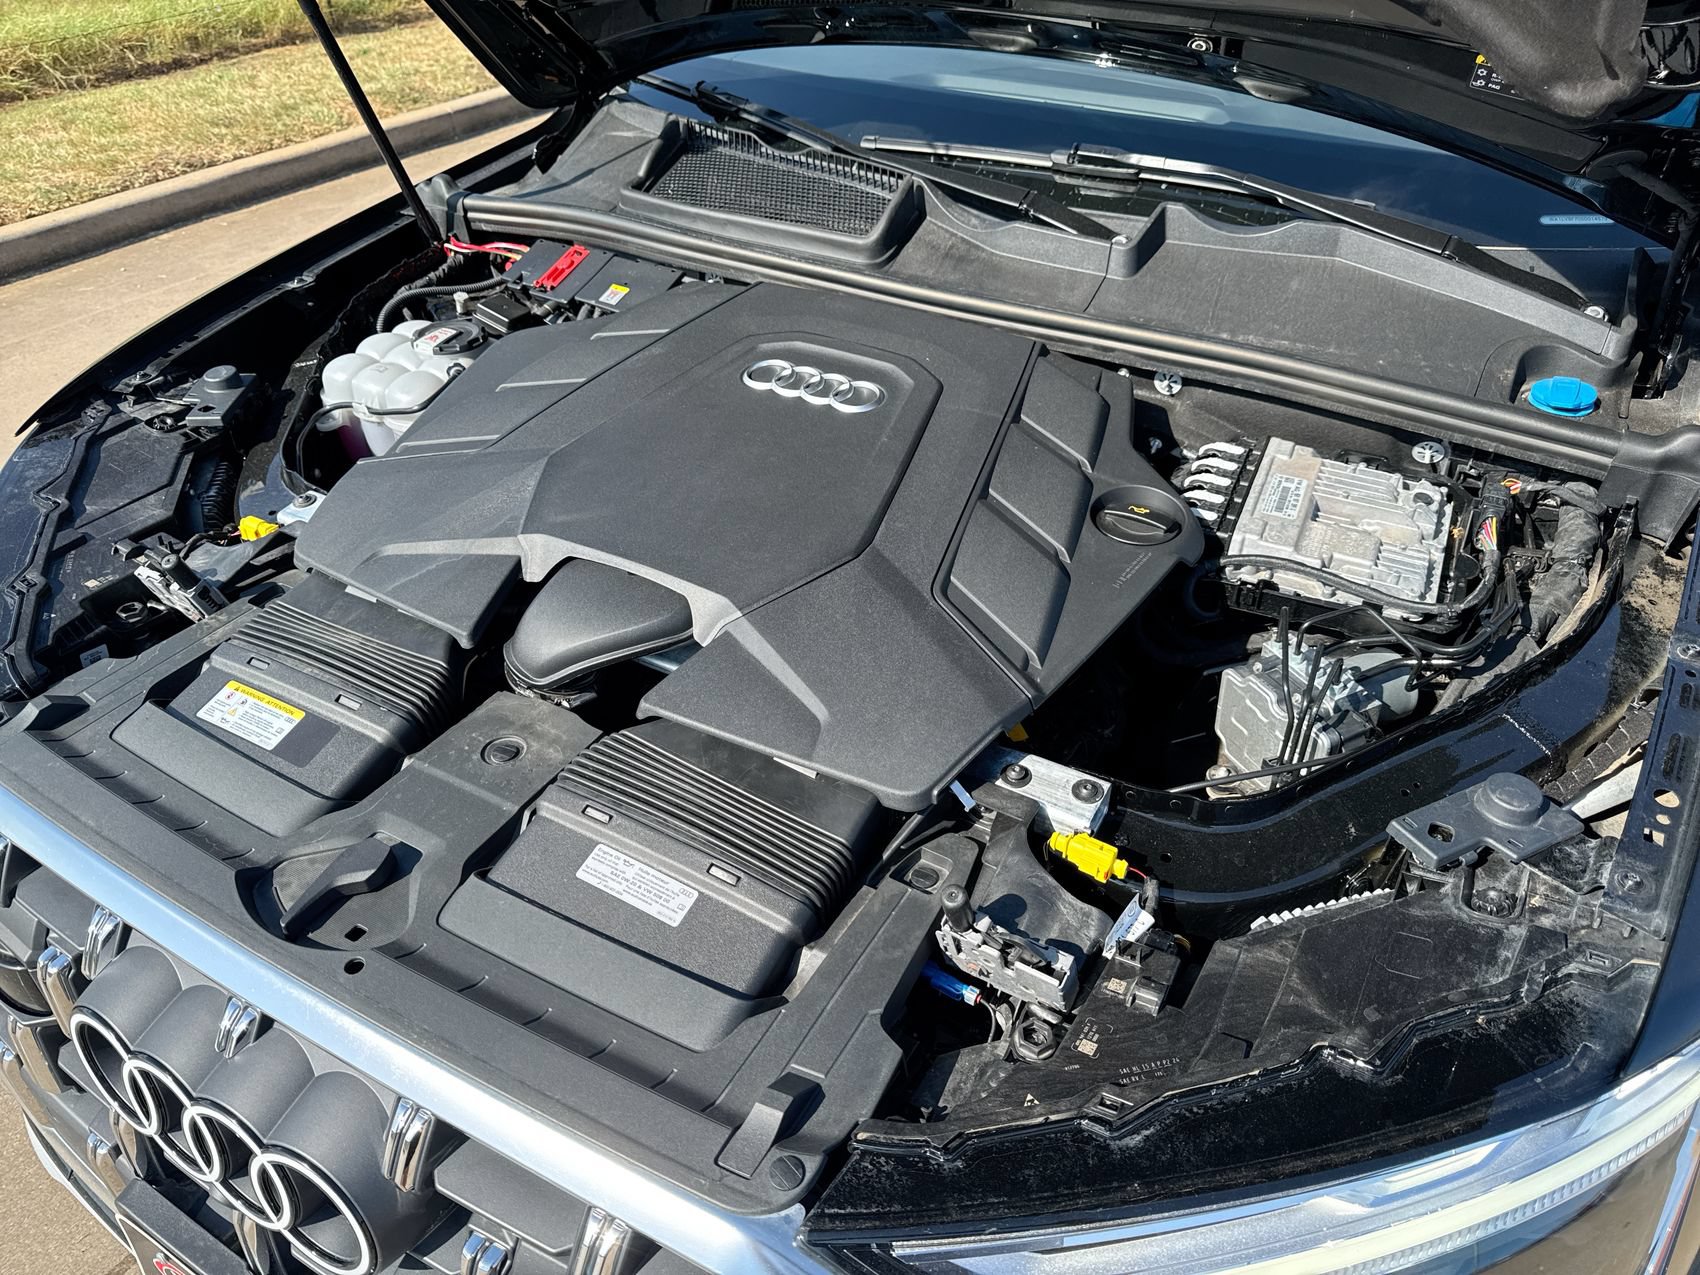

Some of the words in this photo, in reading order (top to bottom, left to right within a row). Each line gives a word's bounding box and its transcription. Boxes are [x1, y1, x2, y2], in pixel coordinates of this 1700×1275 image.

[240, 689, 265, 702] WARNING
[265, 700, 295, 715] ATTENTION
[597, 847, 613, 858] Engine
[651, 874, 669, 884] moteur
